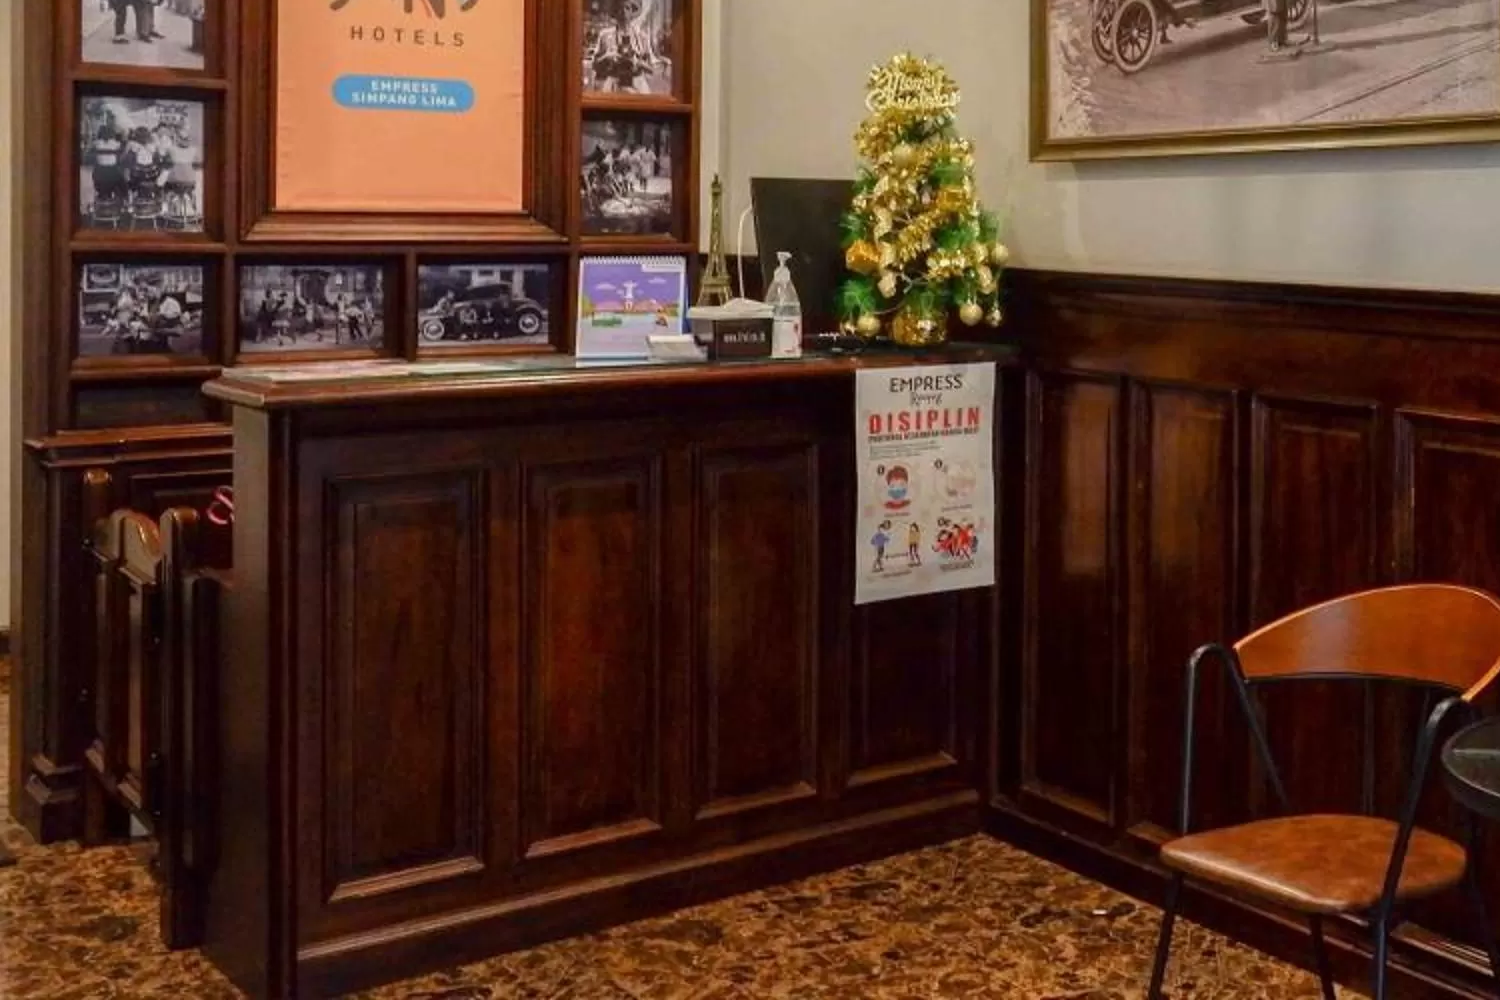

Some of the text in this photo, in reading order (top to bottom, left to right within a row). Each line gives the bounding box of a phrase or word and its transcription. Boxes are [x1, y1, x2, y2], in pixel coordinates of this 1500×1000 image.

[350, 26, 464, 47] HOTELS
[371, 80, 439, 95] EMPRESS
[351, 93, 458, 108] SIMPANG LIMA
[889, 374, 963, 392] EMPRESS
[868, 407, 980, 434] DISIPLIN
